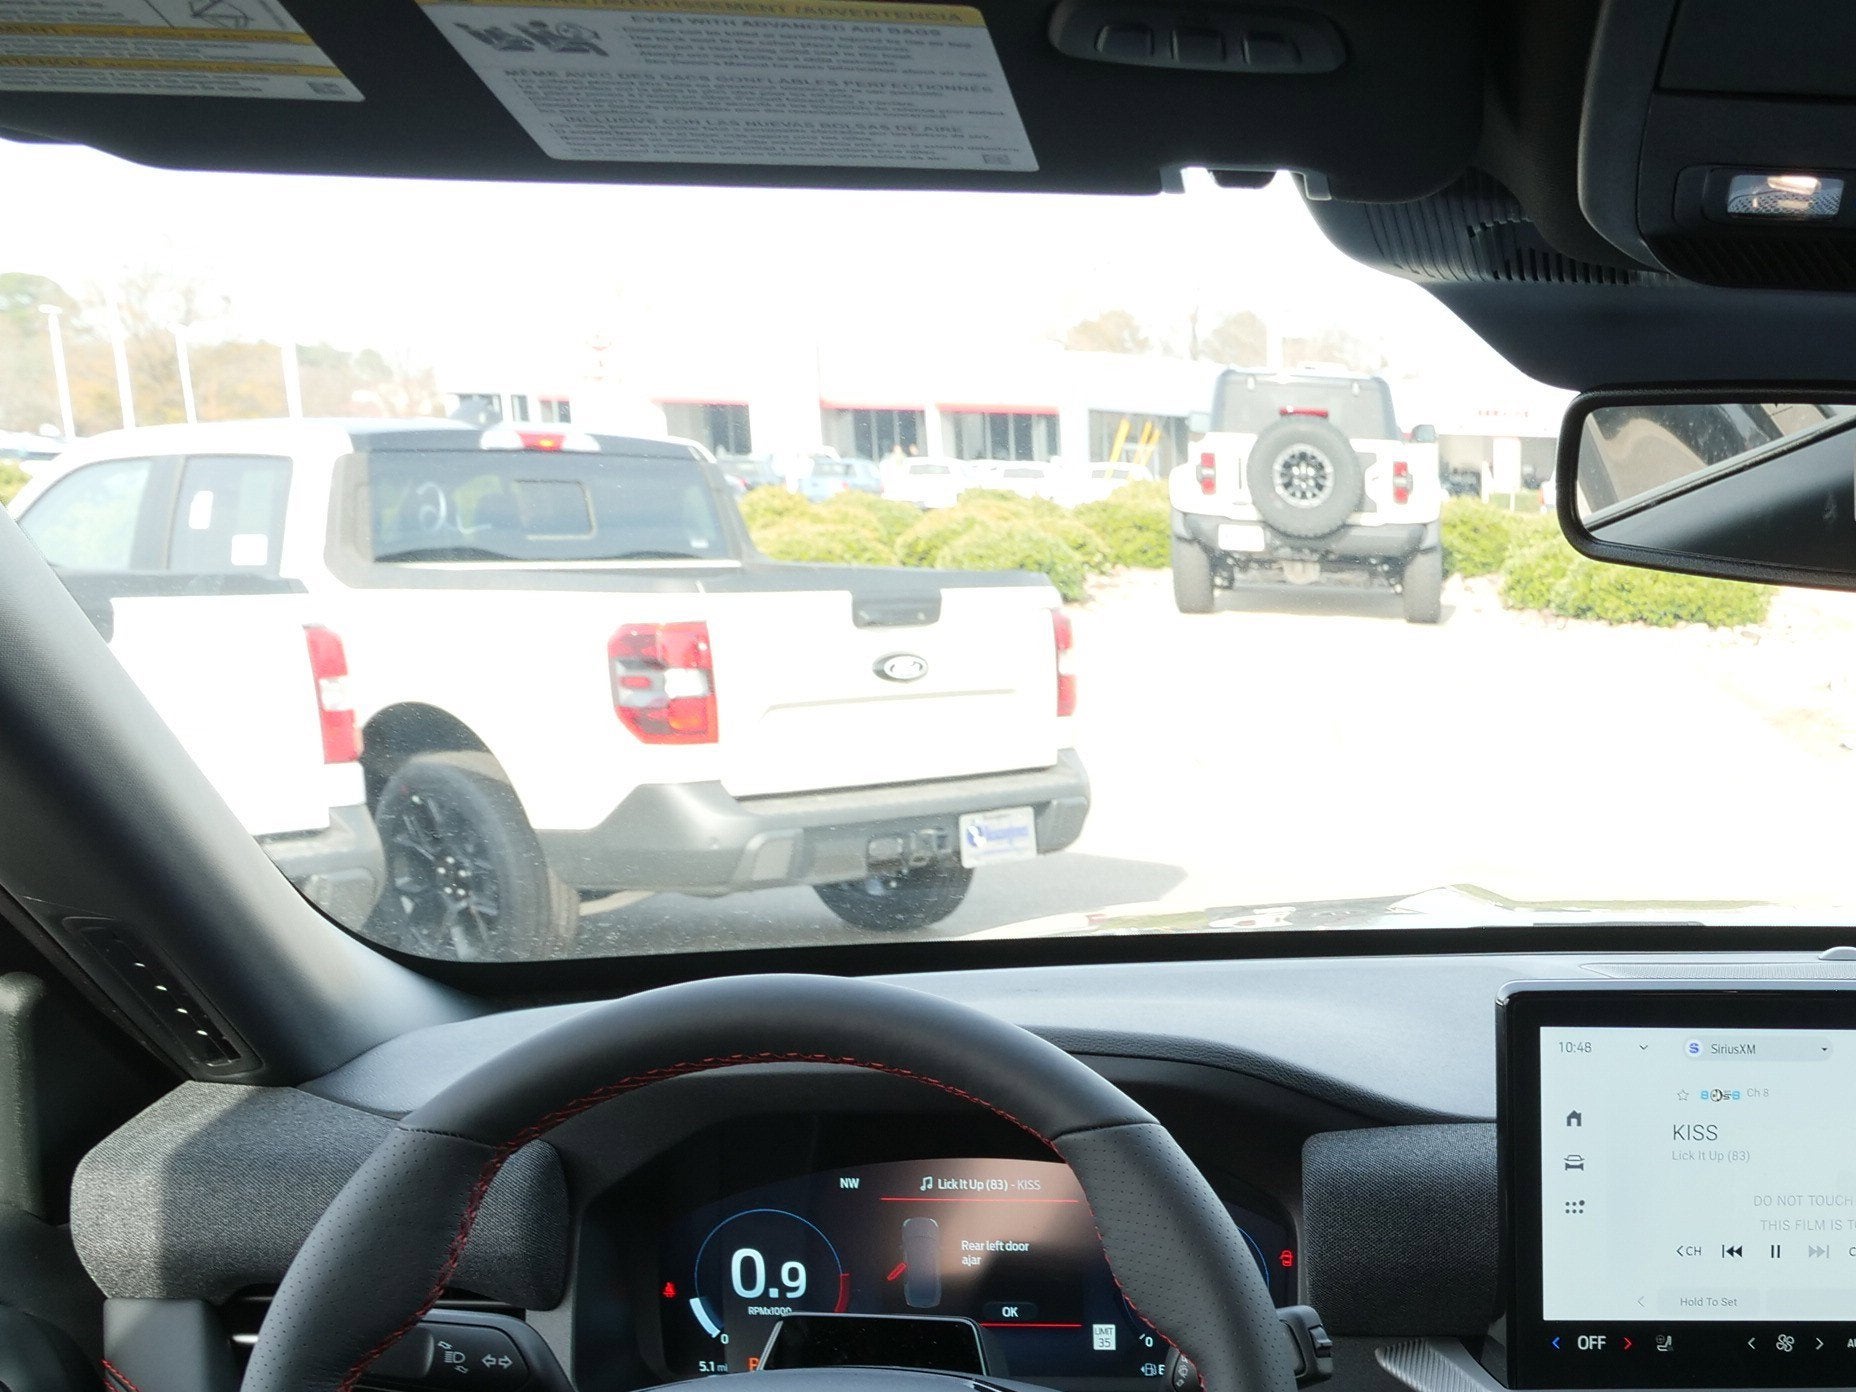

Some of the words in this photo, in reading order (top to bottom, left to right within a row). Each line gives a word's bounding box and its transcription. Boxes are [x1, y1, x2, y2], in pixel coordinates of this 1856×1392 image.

[1559, 1041, 1592, 1053] 10:48
[1710, 1043, 1756, 1055] SiriusXM
[1747, 1087, 1763, 1098] Ch
[1763, 1088, 1770, 1098] 8
[1673, 1124, 1719, 1141] KISS
[1671, 1151, 1695, 1161] Lick
[1698, 1151, 1706, 1161] It
[1709, 1151, 1725, 1164] Up
[1727, 1150, 1751, 1164] (83)
[840, 1178, 860, 1189] NW
[937, 1179, 958, 1190] Lick
[958, 1179, 968, 1190] It
[969, 1179, 984, 1192] Up
[986, 1179, 1008, 1191] (83)
[1017, 1180, 1041, 1190] KISS
[1753, 1195, 1774, 1207] DO
[1777, 1195, 1803, 1207] NOT
[1808, 1195, 1852, 1207] TOUCH
[1760, 1219, 1790, 1231] THIS
[1795, 1219, 1825, 1231] FILM
[1830, 1219, 1843, 1231] IS
[961, 1240, 985, 1251] Rear
[986, 1240, 1005, 1251] left
[1005, 1241, 1030, 1252] door
[1685, 1246, 1702, 1257] CH
[961, 1255, 982, 1267] ajar
[731, 1248, 807, 1299] 0.9
[1680, 1296, 1703, 1307] Hold
[1706, 1297, 1719, 1307] To
[1721, 1297, 1738, 1307] Set
[1001, 1306, 1019, 1318] OK
[1094, 1327, 1114, 1336] LIMIT
[720, 1333, 729, 1345] 0
[1098, 1338, 1111, 1348] 35
[1145, 1336, 1154, 1347] 0
[1577, 1335, 1606, 1349] OFF
[699, 1361, 715, 1372] 5.1
[716, 1363, 729, 1372] mi
[1157, 1364, 1166, 1376] E
